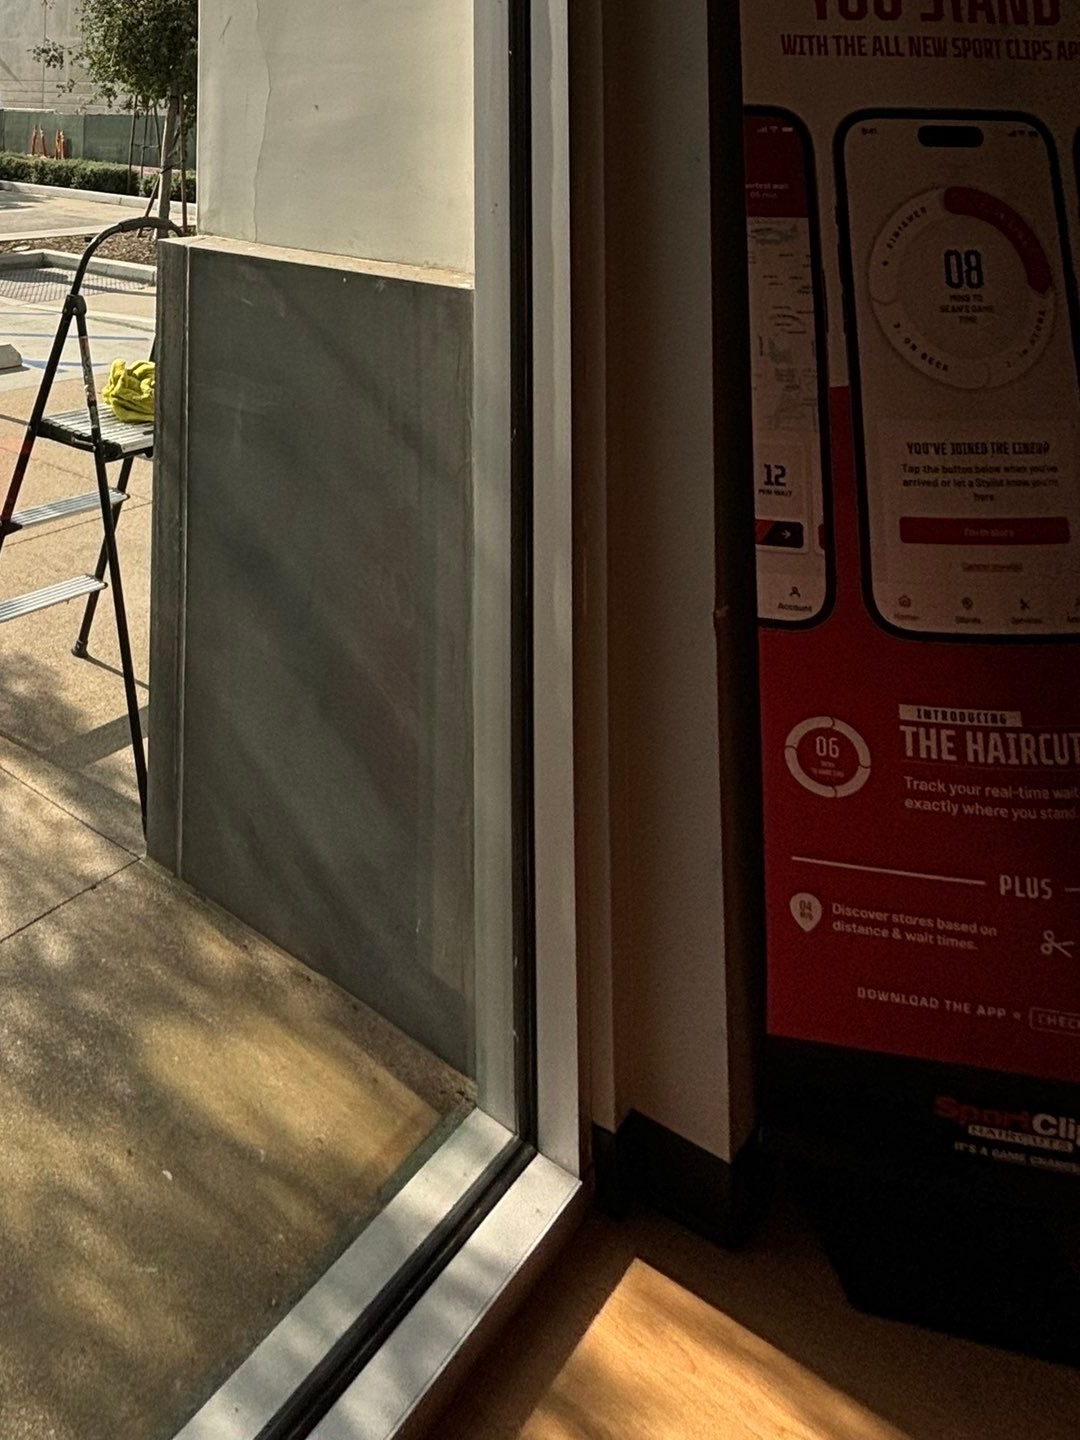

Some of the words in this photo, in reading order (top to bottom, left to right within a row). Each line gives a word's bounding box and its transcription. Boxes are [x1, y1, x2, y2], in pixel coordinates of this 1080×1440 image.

[781, 34, 829, 57] WITH
[832, 35, 867, 57] THE
[873, 35, 905, 57] ALL
[909, 35, 947, 58] NEW
[952, 37, 1001, 59] SPORT
[1006, 39, 1052, 60] CLIPS
[1057, 41, 1080, 61] AP
[943, 249, 984, 289] 08
[906, 441, 947, 455] YOU'VE
[990, 441, 1010, 455] THE
[764, 464, 786, 486] 12
[922, 464, 939, 474] the
[816, 735, 840, 759] 06
[899, 725, 958, 761] THE
[966, 730, 1080, 765] HAIRCUT
[904, 775, 946, 793] Track
[949, 783, 982, 797] your
[984, 785, 1050, 800] real-time
[904, 797, 959, 816] exactly
[962, 802, 1008, 818] where
[1012, 808, 1038, 822] you
[999, 873, 1053, 900] PLUS
[831, 902, 890, 922] Discover
[892, 910, 935, 928] stores
[937, 916, 978, 934] based
[980, 923, 998, 937] on
[832, 918, 889, 939] distance
[891, 926, 902, 940] &
[905, 930, 935, 945] wait
[857, 986, 939, 1010] DOWNLOAD
[944, 999, 971, 1014] THE
[976, 1004, 1007, 1020] APP
